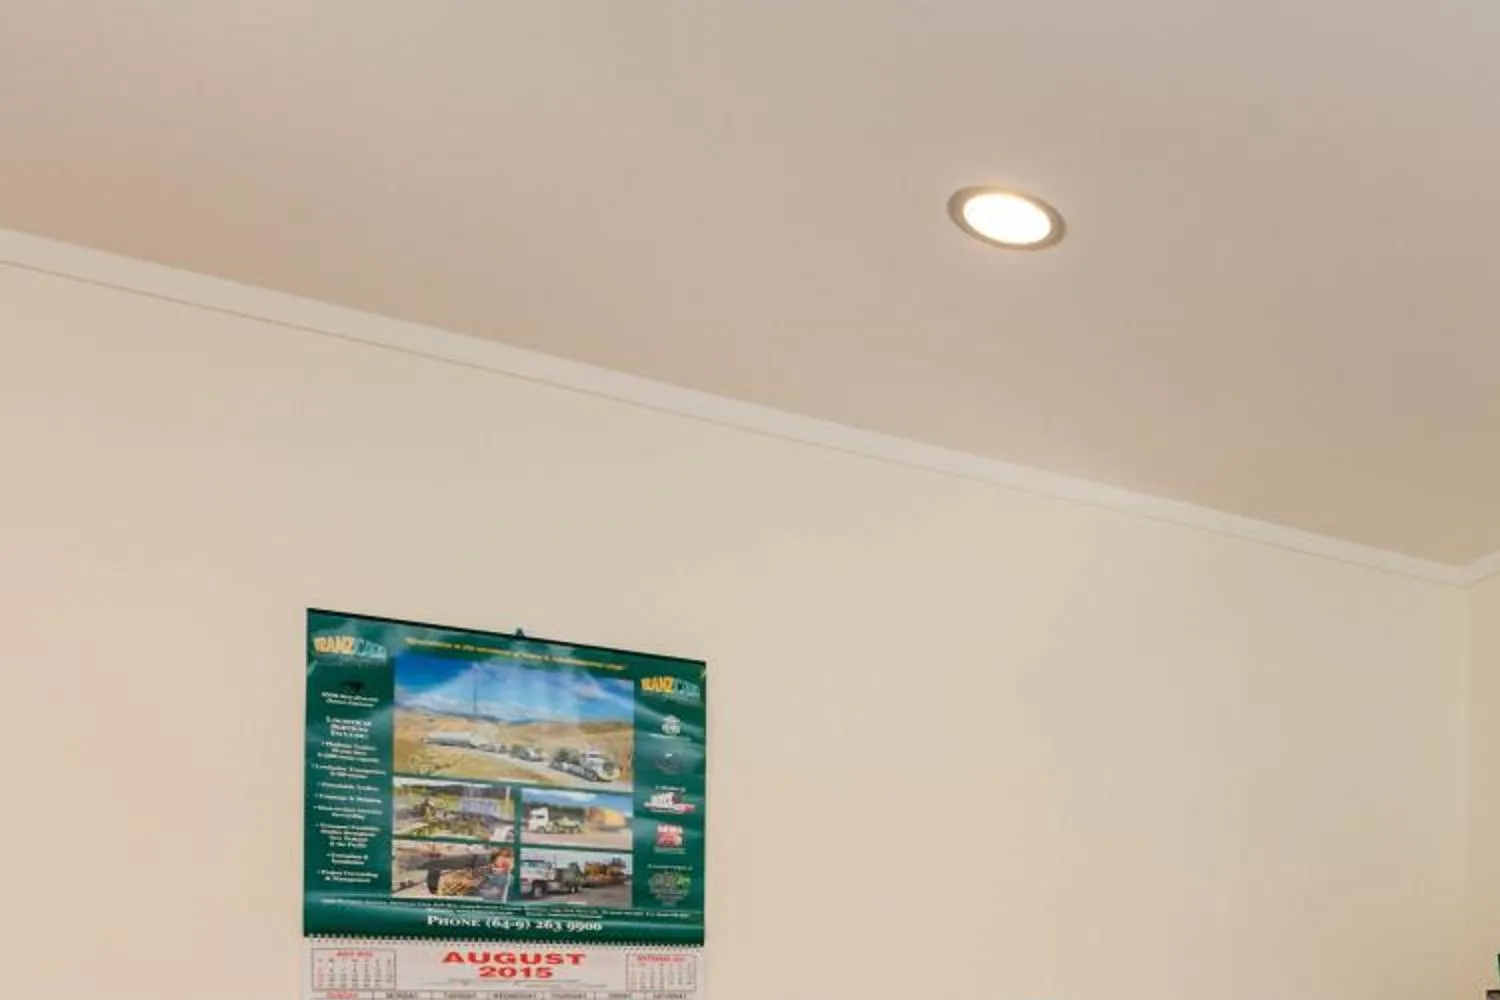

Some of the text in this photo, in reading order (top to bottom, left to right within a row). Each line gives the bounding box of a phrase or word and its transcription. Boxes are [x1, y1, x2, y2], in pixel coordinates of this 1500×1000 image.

[427, 915, 602, 933] PHONE (64-9) 263 9900
[442, 951, 586, 966] AUGUST
[479, 966, 553, 978] 2015
